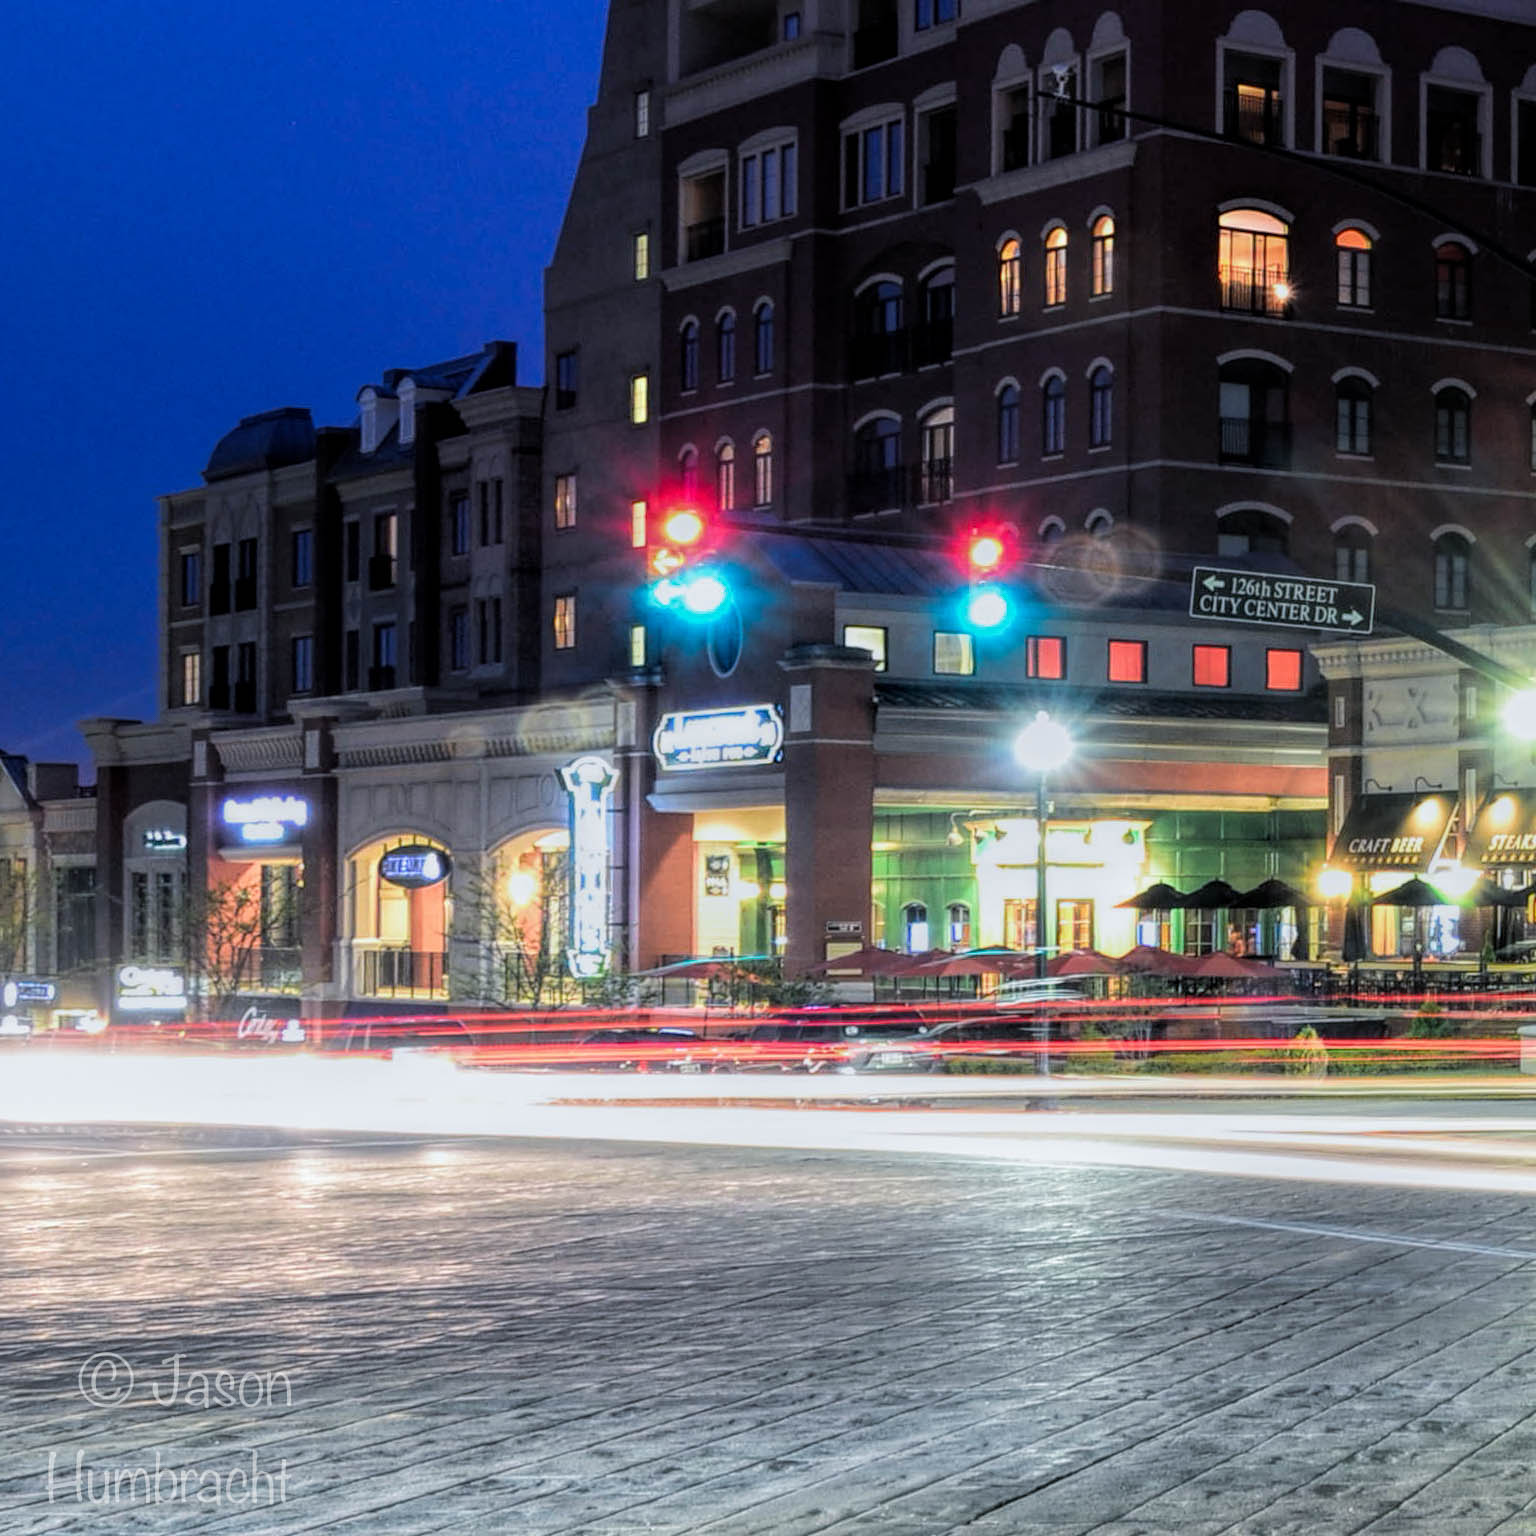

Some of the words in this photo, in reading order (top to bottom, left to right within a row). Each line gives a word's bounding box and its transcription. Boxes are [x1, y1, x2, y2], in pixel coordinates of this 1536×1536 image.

[1231, 577, 1271, 599] 126th
[1273, 581, 1339, 605] STREET
[1199, 594, 1244, 615] CITY
[1244, 598, 1311, 623] CENTER
[1314, 606, 1338, 625] DR
[1349, 838, 1391, 853] CRAFT
[1390, 836, 1424, 853] BEER
